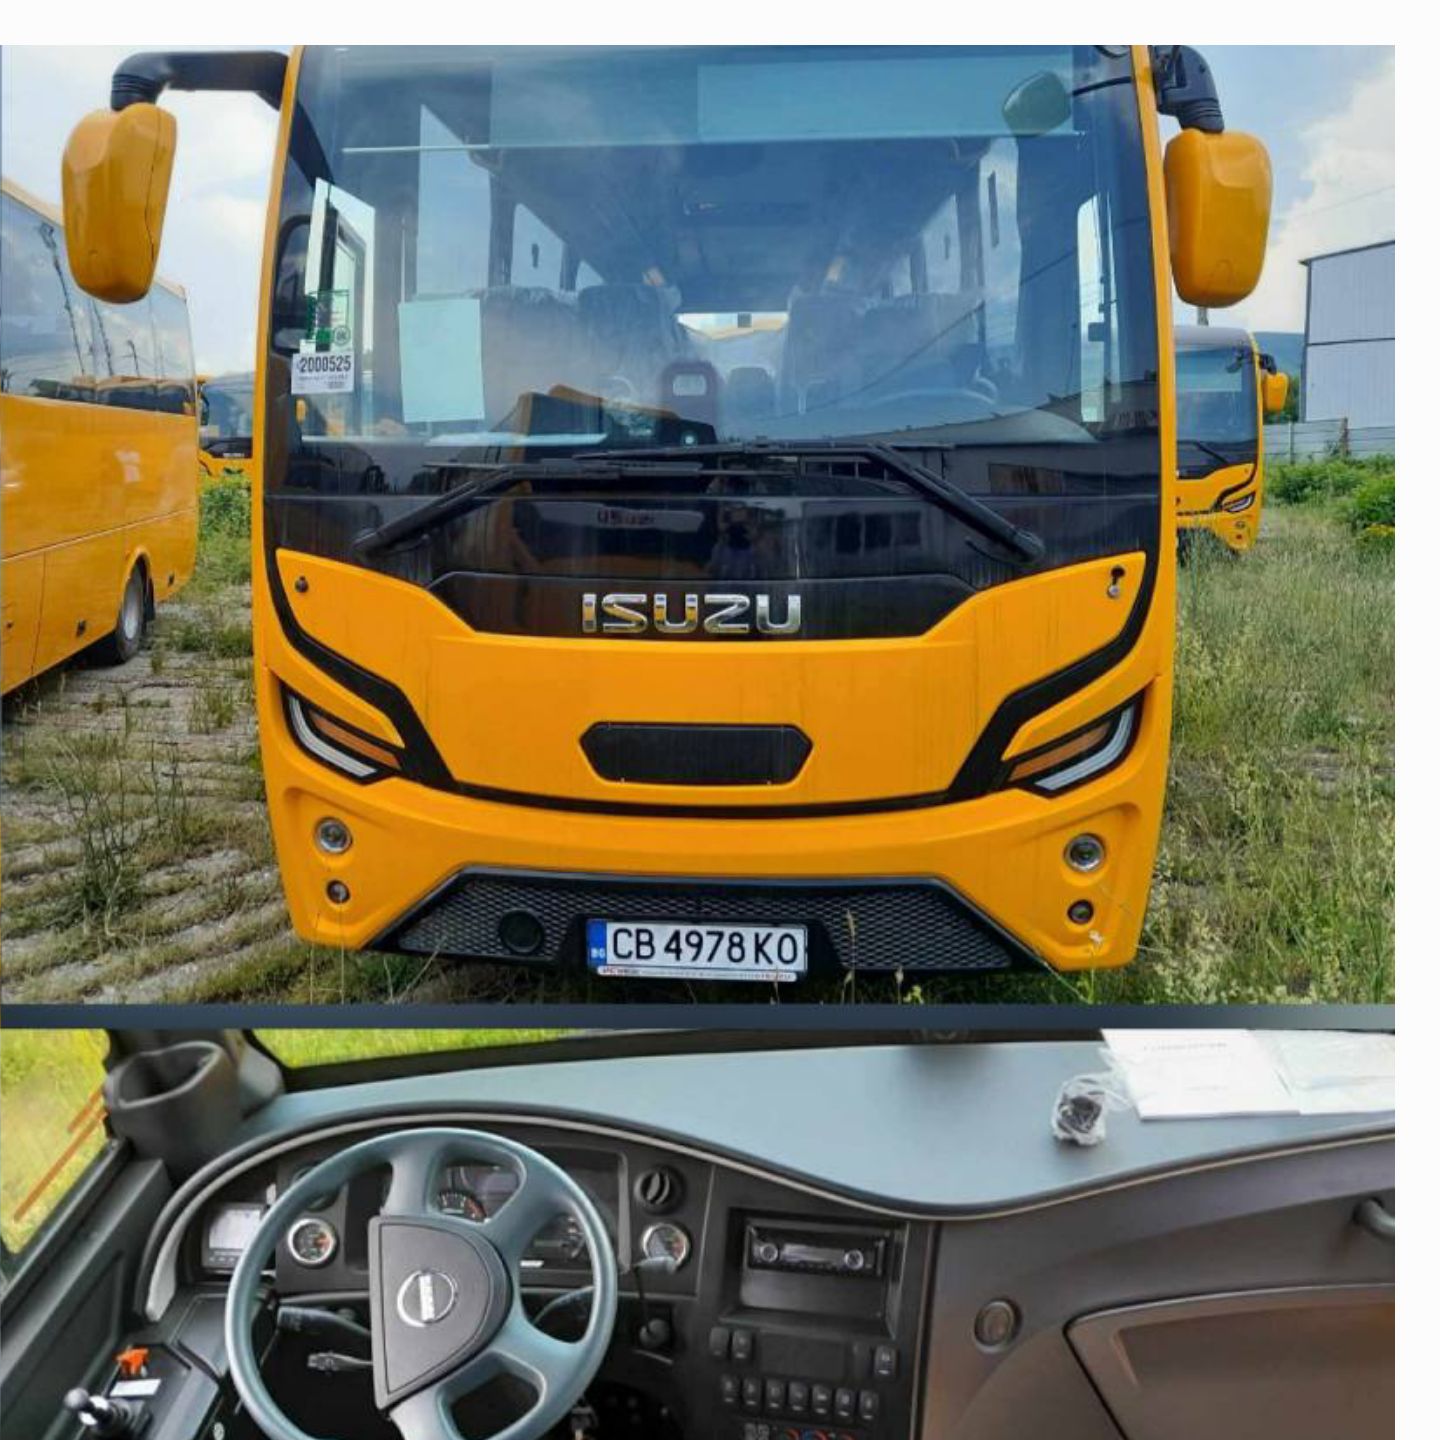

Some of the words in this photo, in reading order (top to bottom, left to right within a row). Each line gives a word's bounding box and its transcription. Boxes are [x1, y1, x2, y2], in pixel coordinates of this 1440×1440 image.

[300, 355, 351, 372] 2000525
[582, 593, 802, 633] ISUZU
[613, 928, 655, 960] CB
[664, 930, 745, 963] 4978
